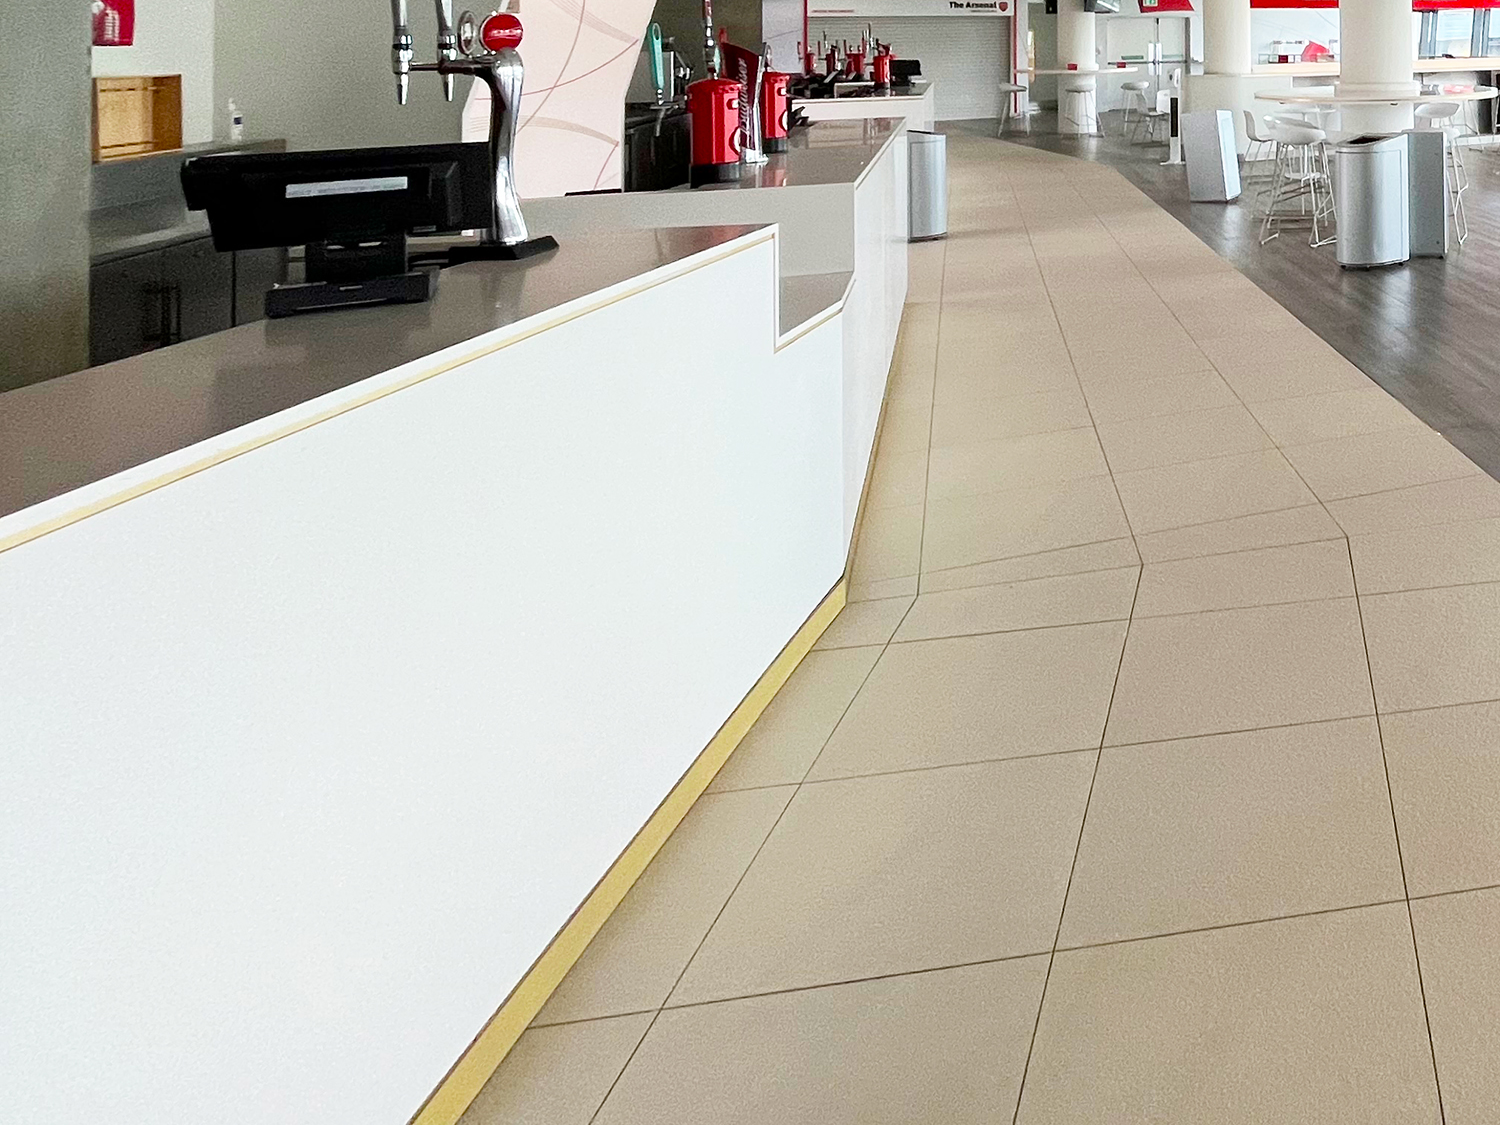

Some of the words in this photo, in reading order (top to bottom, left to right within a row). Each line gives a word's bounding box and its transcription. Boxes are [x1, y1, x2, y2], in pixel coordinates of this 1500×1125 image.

[949, 1, 964, 9] The
[965, 1, 997, 9] Arsenal
[737, 57, 749, 135] Budweiser
